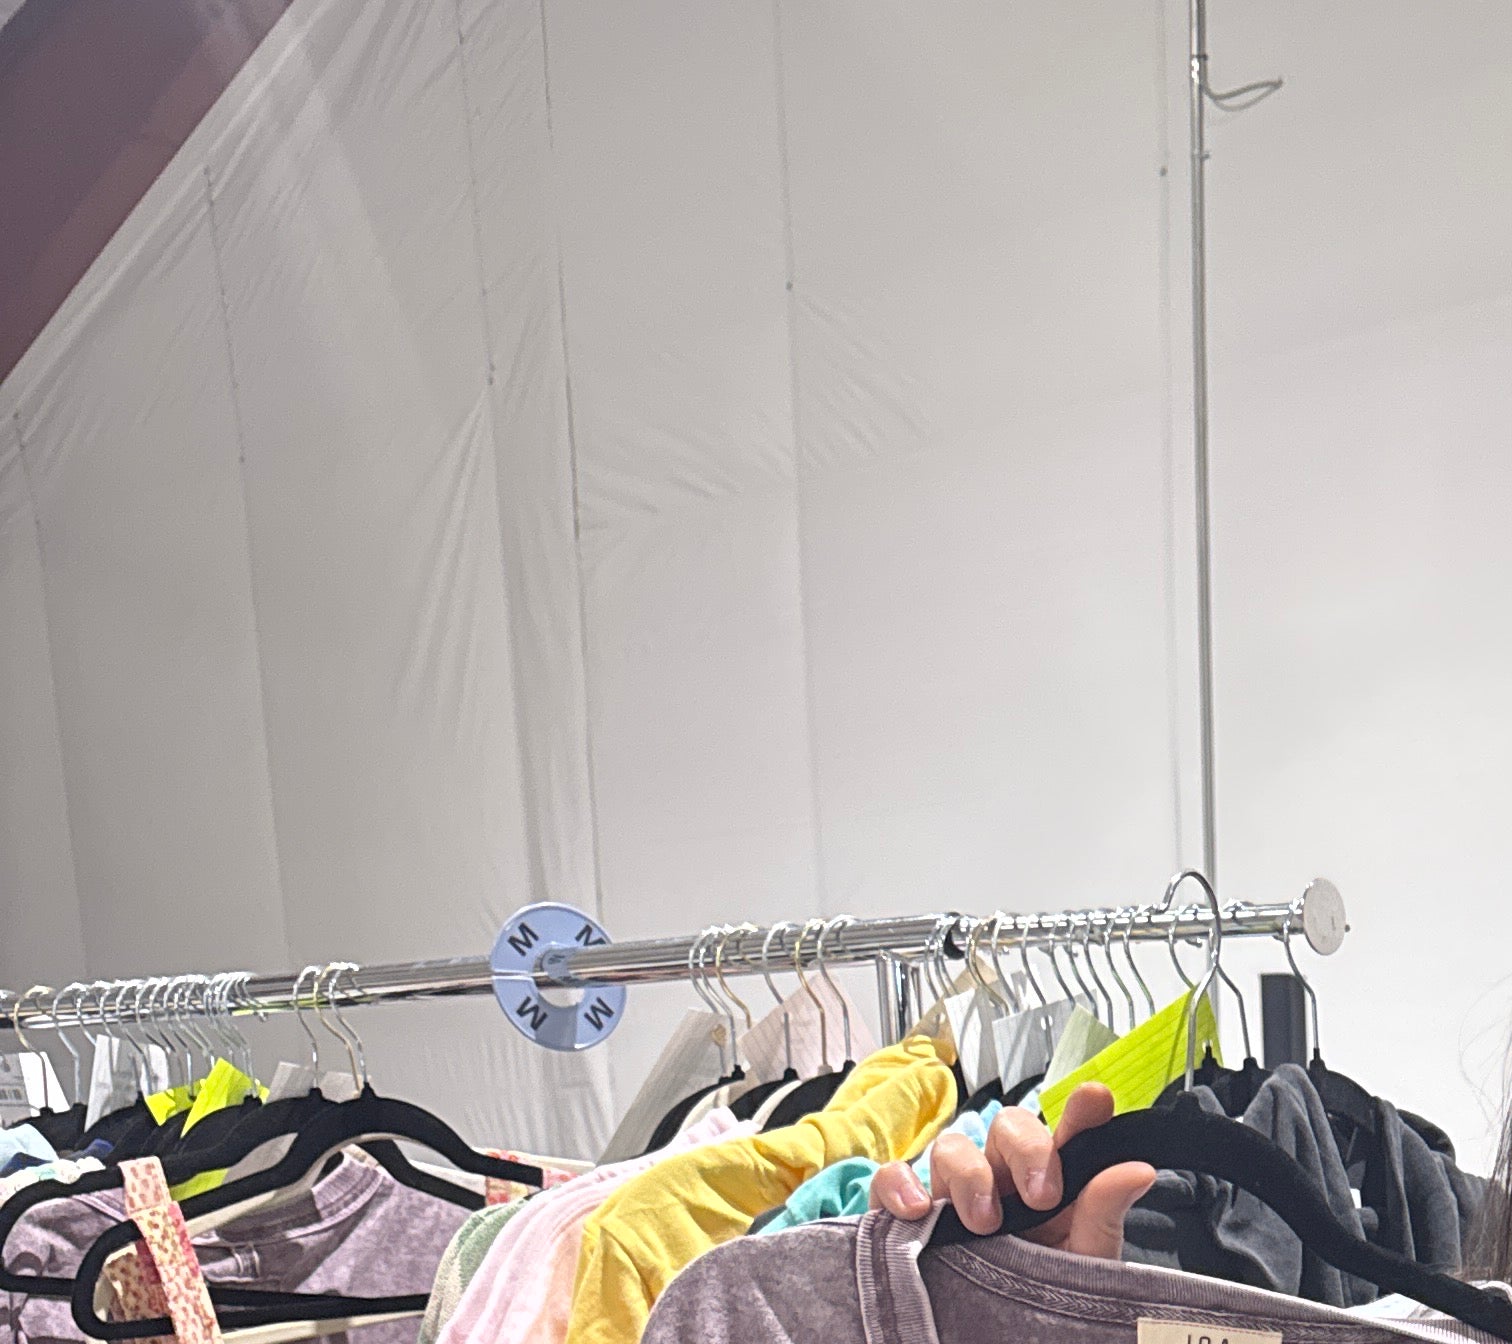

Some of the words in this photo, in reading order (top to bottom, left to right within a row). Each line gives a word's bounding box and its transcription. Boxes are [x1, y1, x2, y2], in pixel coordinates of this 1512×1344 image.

[508, 923, 539, 956] M
[517, 997, 547, 1030] M
[584, 998, 614, 1031] M
